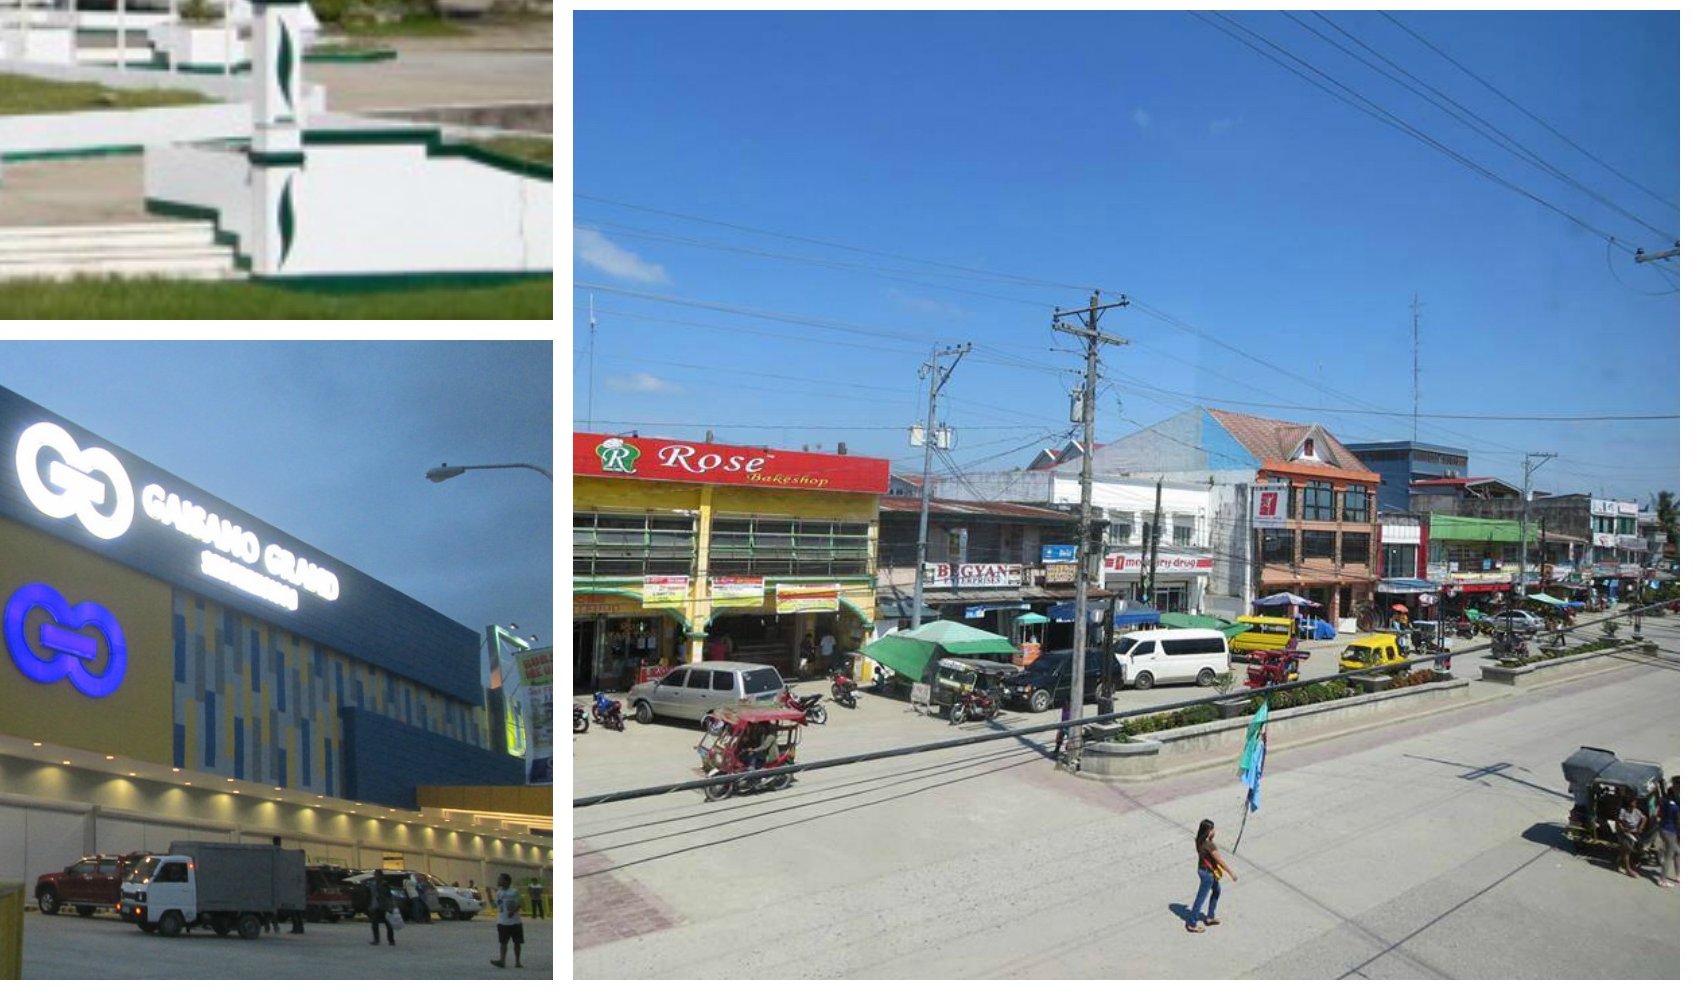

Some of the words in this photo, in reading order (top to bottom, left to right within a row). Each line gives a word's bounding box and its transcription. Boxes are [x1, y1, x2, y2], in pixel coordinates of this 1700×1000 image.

[658, 445, 764, 474] Rose
[746, 472, 829, 487] Bakeshop
[141, 483, 260, 564] GAISANO
[264, 543, 340, 601] GRAND
